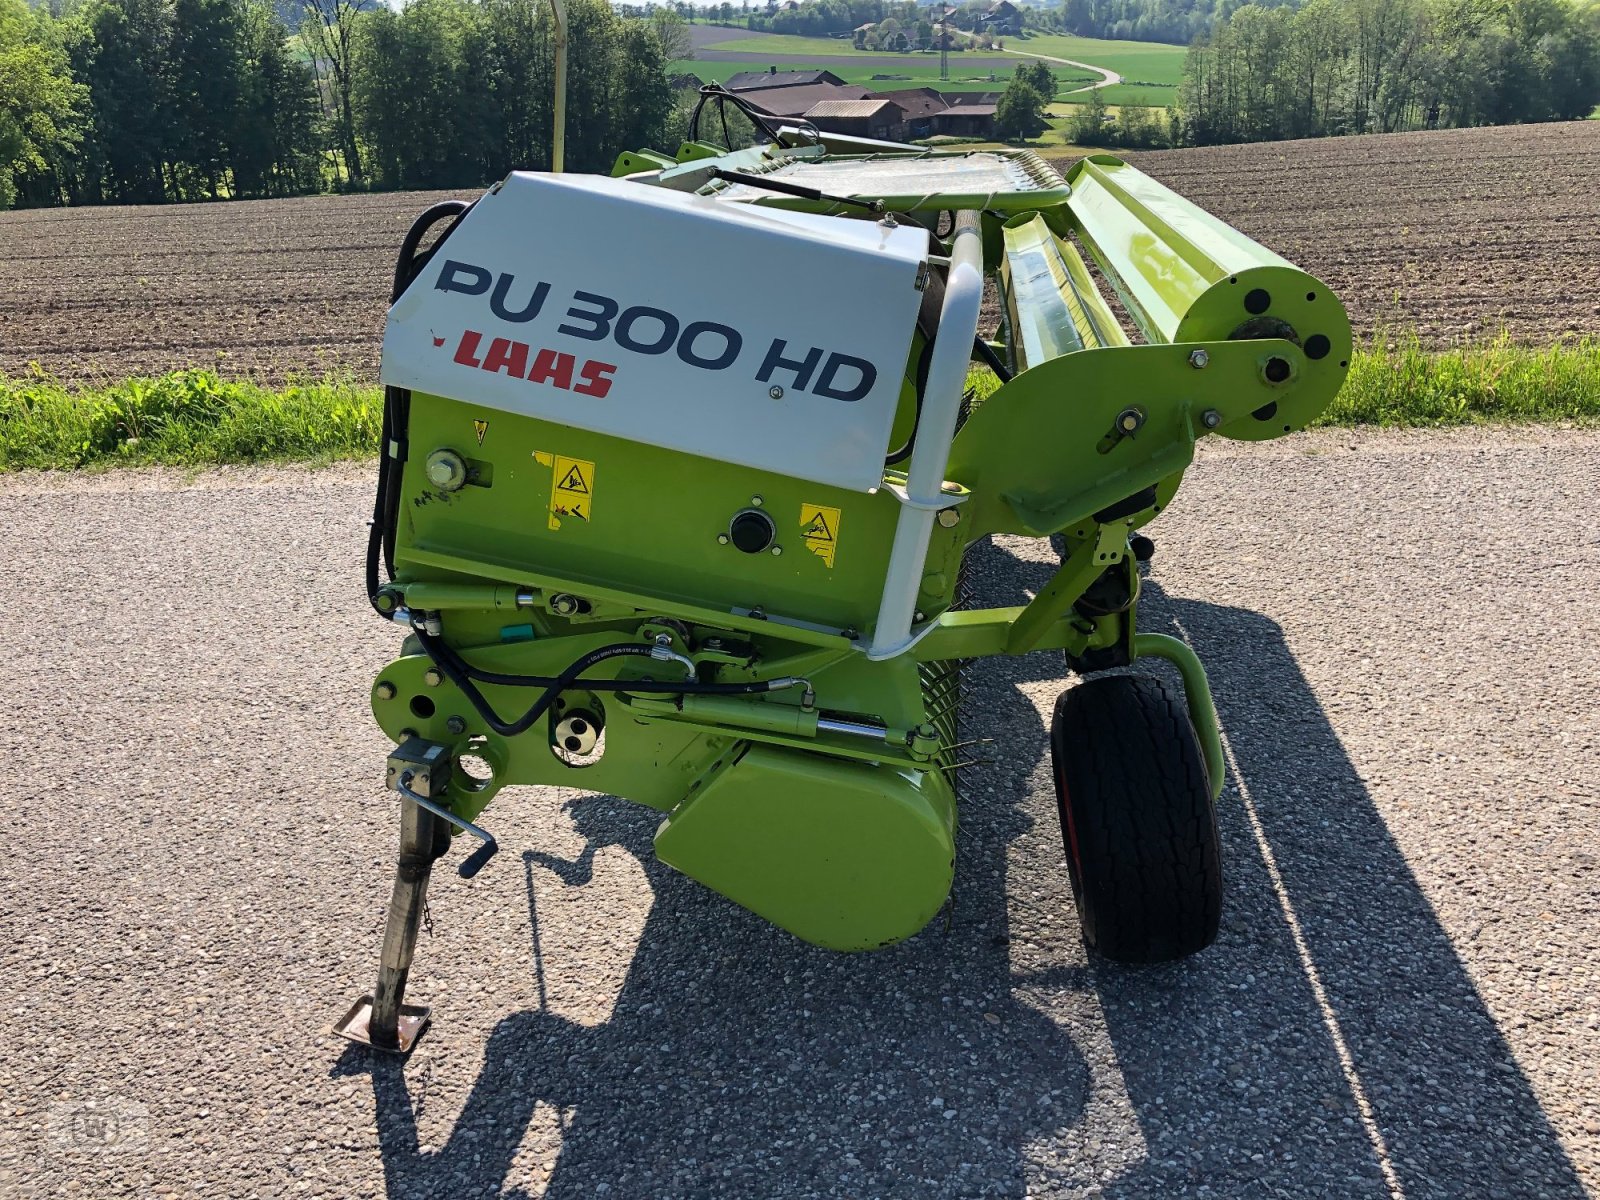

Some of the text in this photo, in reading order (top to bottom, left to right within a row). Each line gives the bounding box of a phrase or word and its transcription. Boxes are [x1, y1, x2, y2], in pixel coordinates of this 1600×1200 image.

[432, 330, 618, 398] LAAS
[434, 259, 878, 402] PU 300 HD
